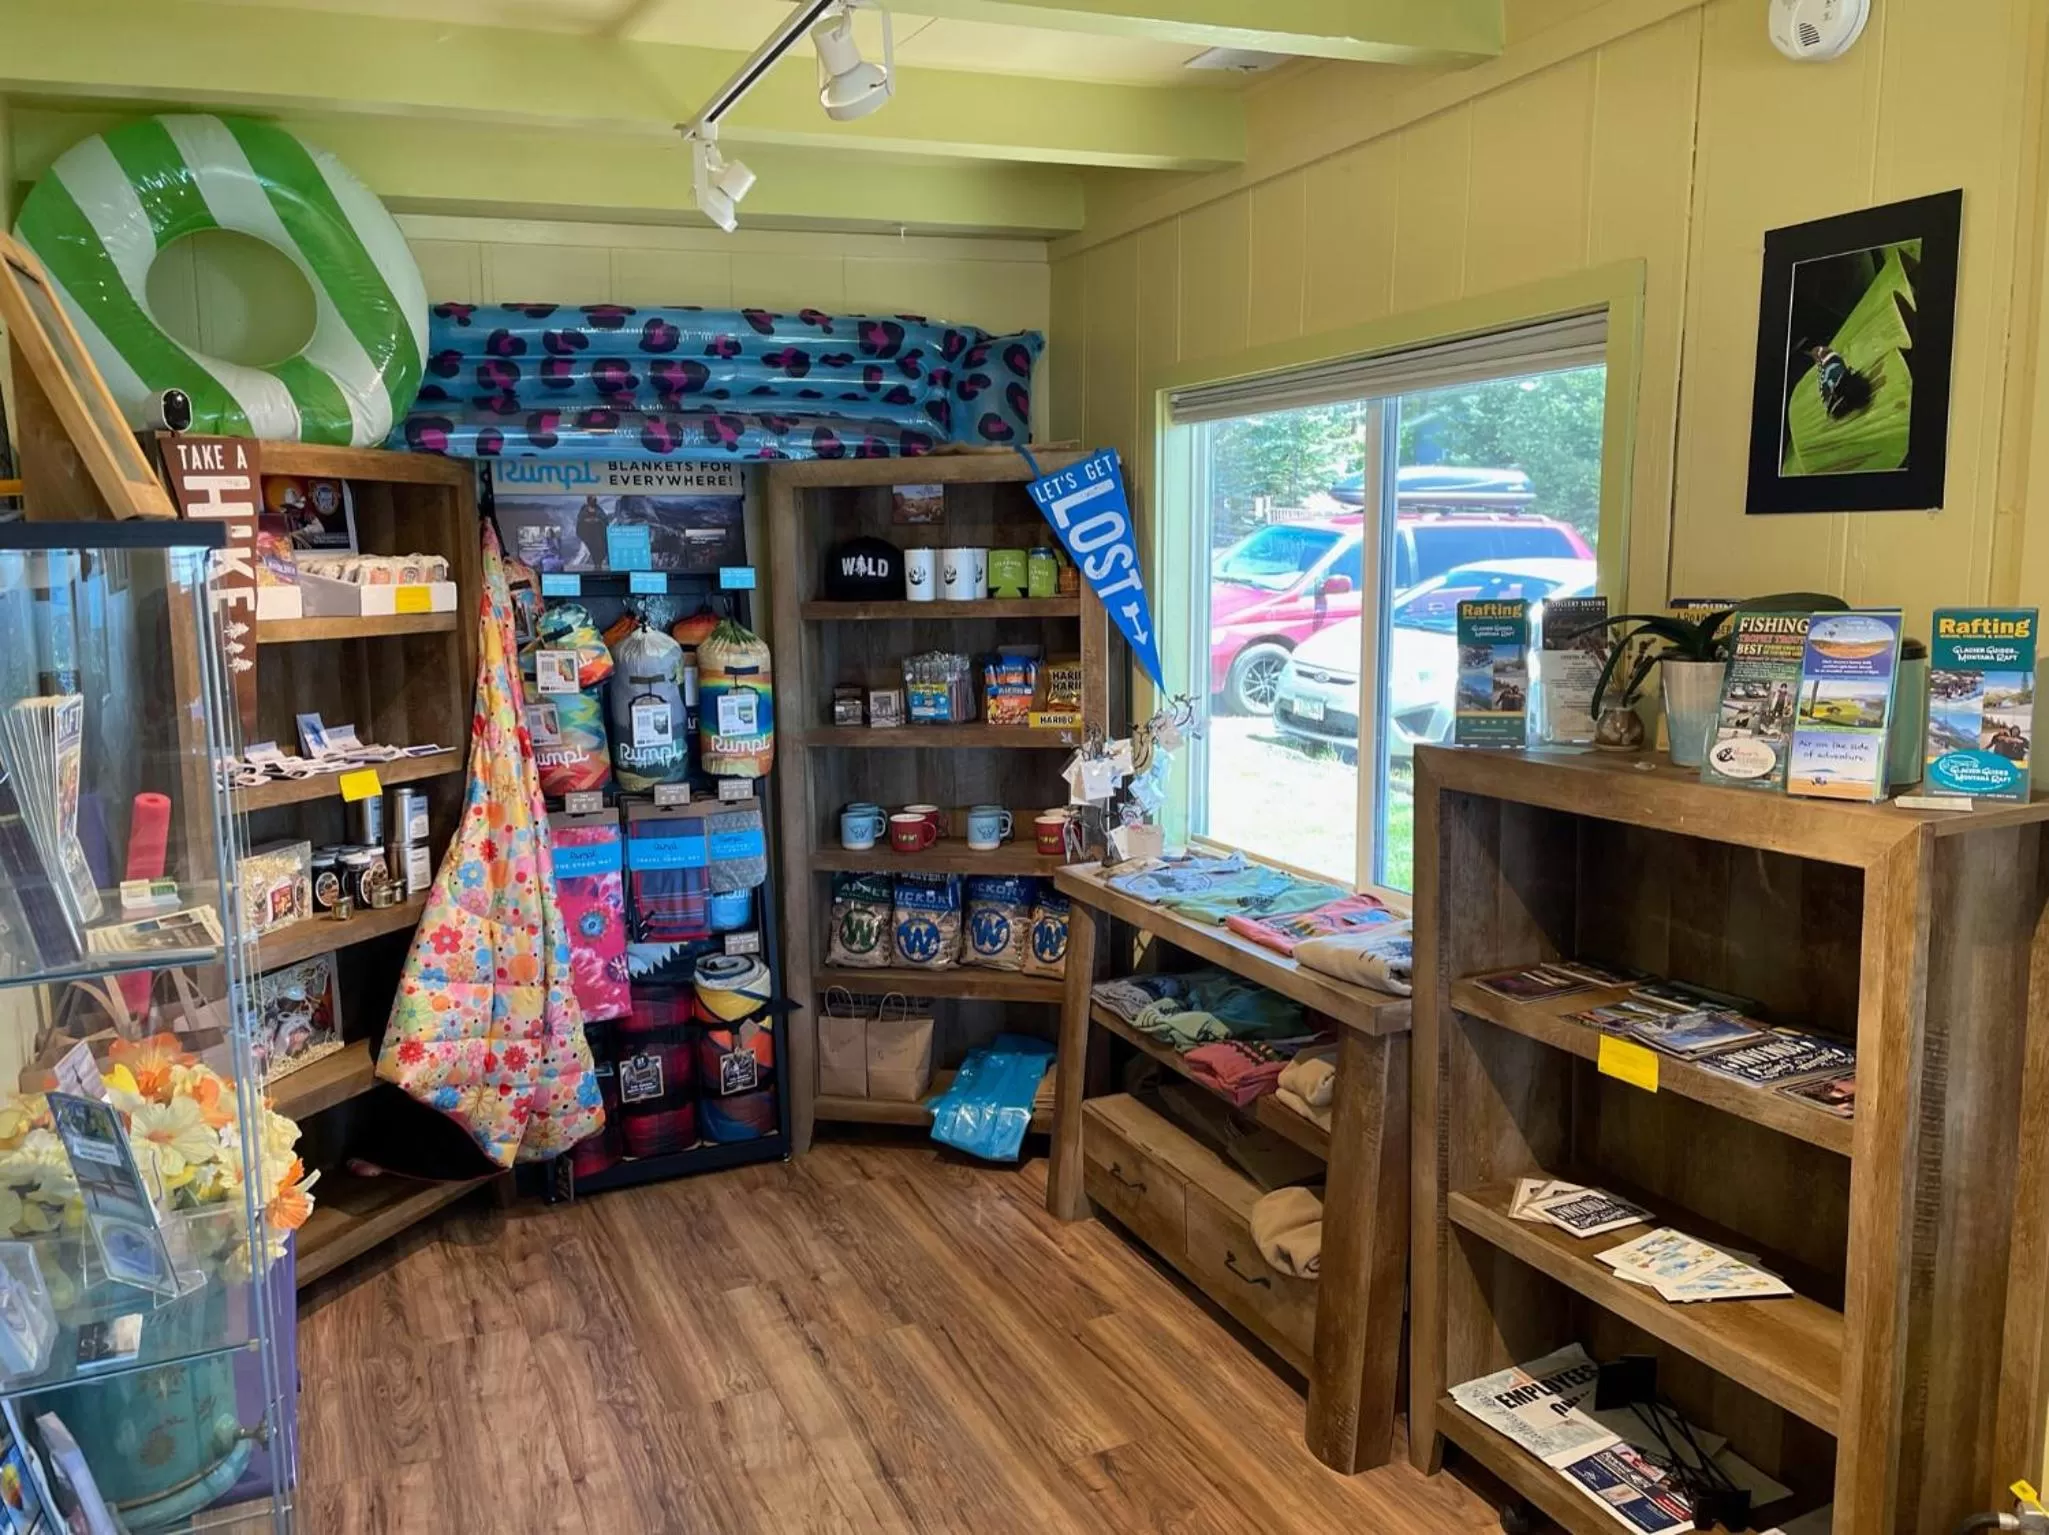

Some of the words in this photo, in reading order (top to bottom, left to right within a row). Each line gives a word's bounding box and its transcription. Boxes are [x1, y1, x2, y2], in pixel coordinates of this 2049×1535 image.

[177, 444, 225, 470] TAKE
[236, 444, 249, 470] A
[608, 460, 695, 472] BLANKETS
[700, 461, 732, 472] FOR
[496, 459, 600, 491] Rumpl
[609, 474, 734, 487] EVERYWHERE!
[1035, 471, 1078, 504] LET'S
[1084, 455, 1114, 482] GET
[1050, 478, 1143, 599] LOST
[1462, 603, 1523, 617] Rafting
[1738, 616, 1810, 633] FISHING
[1939, 617, 2031, 639] Rafting
[1736, 644, 1764, 655] BEST
[1052, 671, 1081, 680] HARI
[1053, 681, 1081, 691] HARI
[1040, 716, 1073, 724] HARIBO
[619, 740, 688, 767] Rumpl
[711, 733, 771, 756] Rumpl
[536, 744, 590, 769] umpl
[1493, 1363, 1600, 1410] EMPLOYEES
